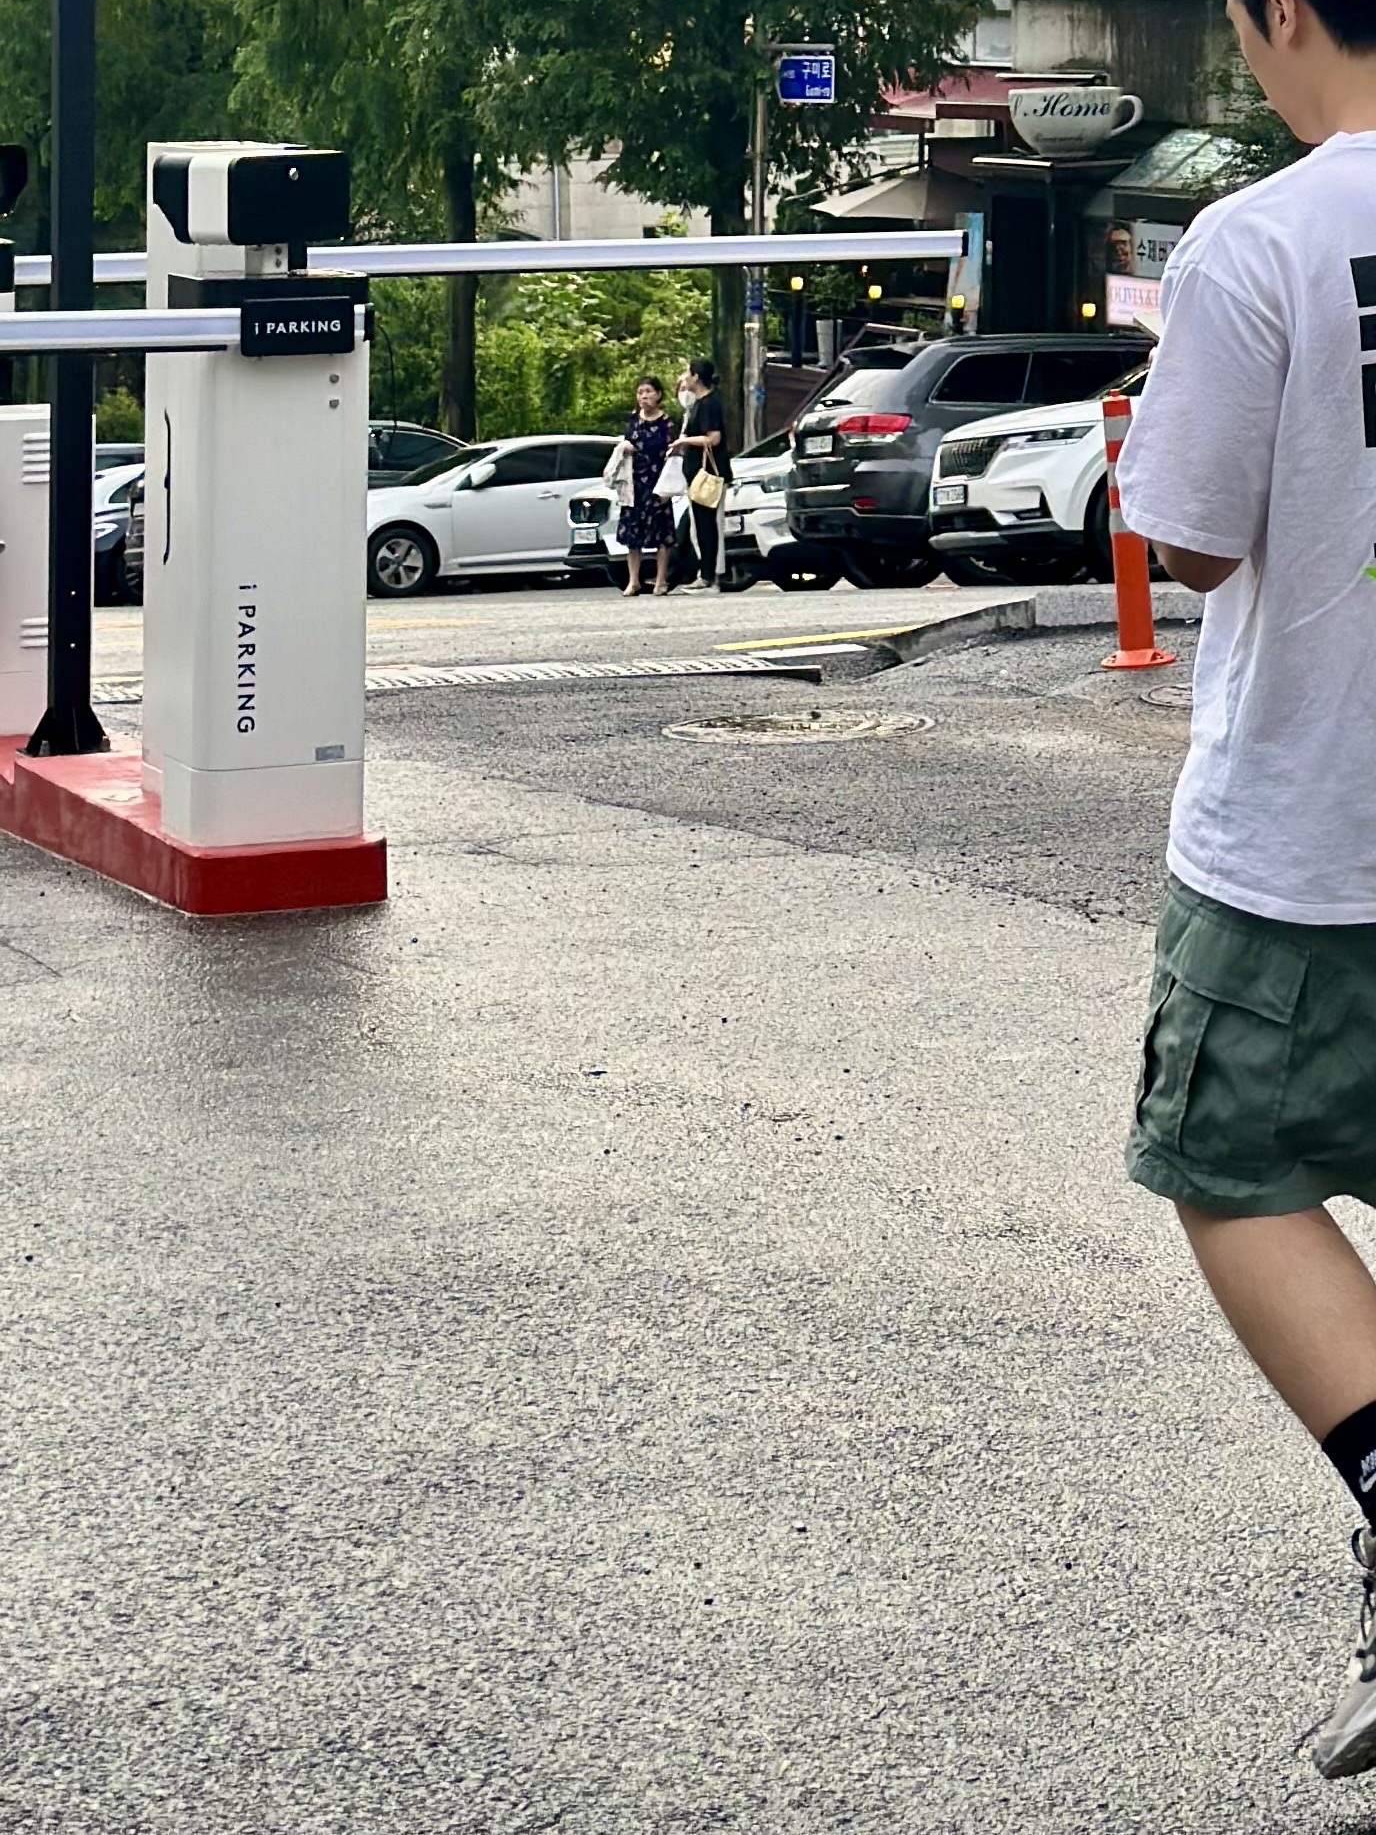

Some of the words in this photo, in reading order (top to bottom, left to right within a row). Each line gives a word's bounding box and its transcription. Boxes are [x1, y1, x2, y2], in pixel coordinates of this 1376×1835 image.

[1033, 92, 1110, 117] Home
[266, 319, 342, 334] PARKING
[236, 605, 257, 734] PARKING
